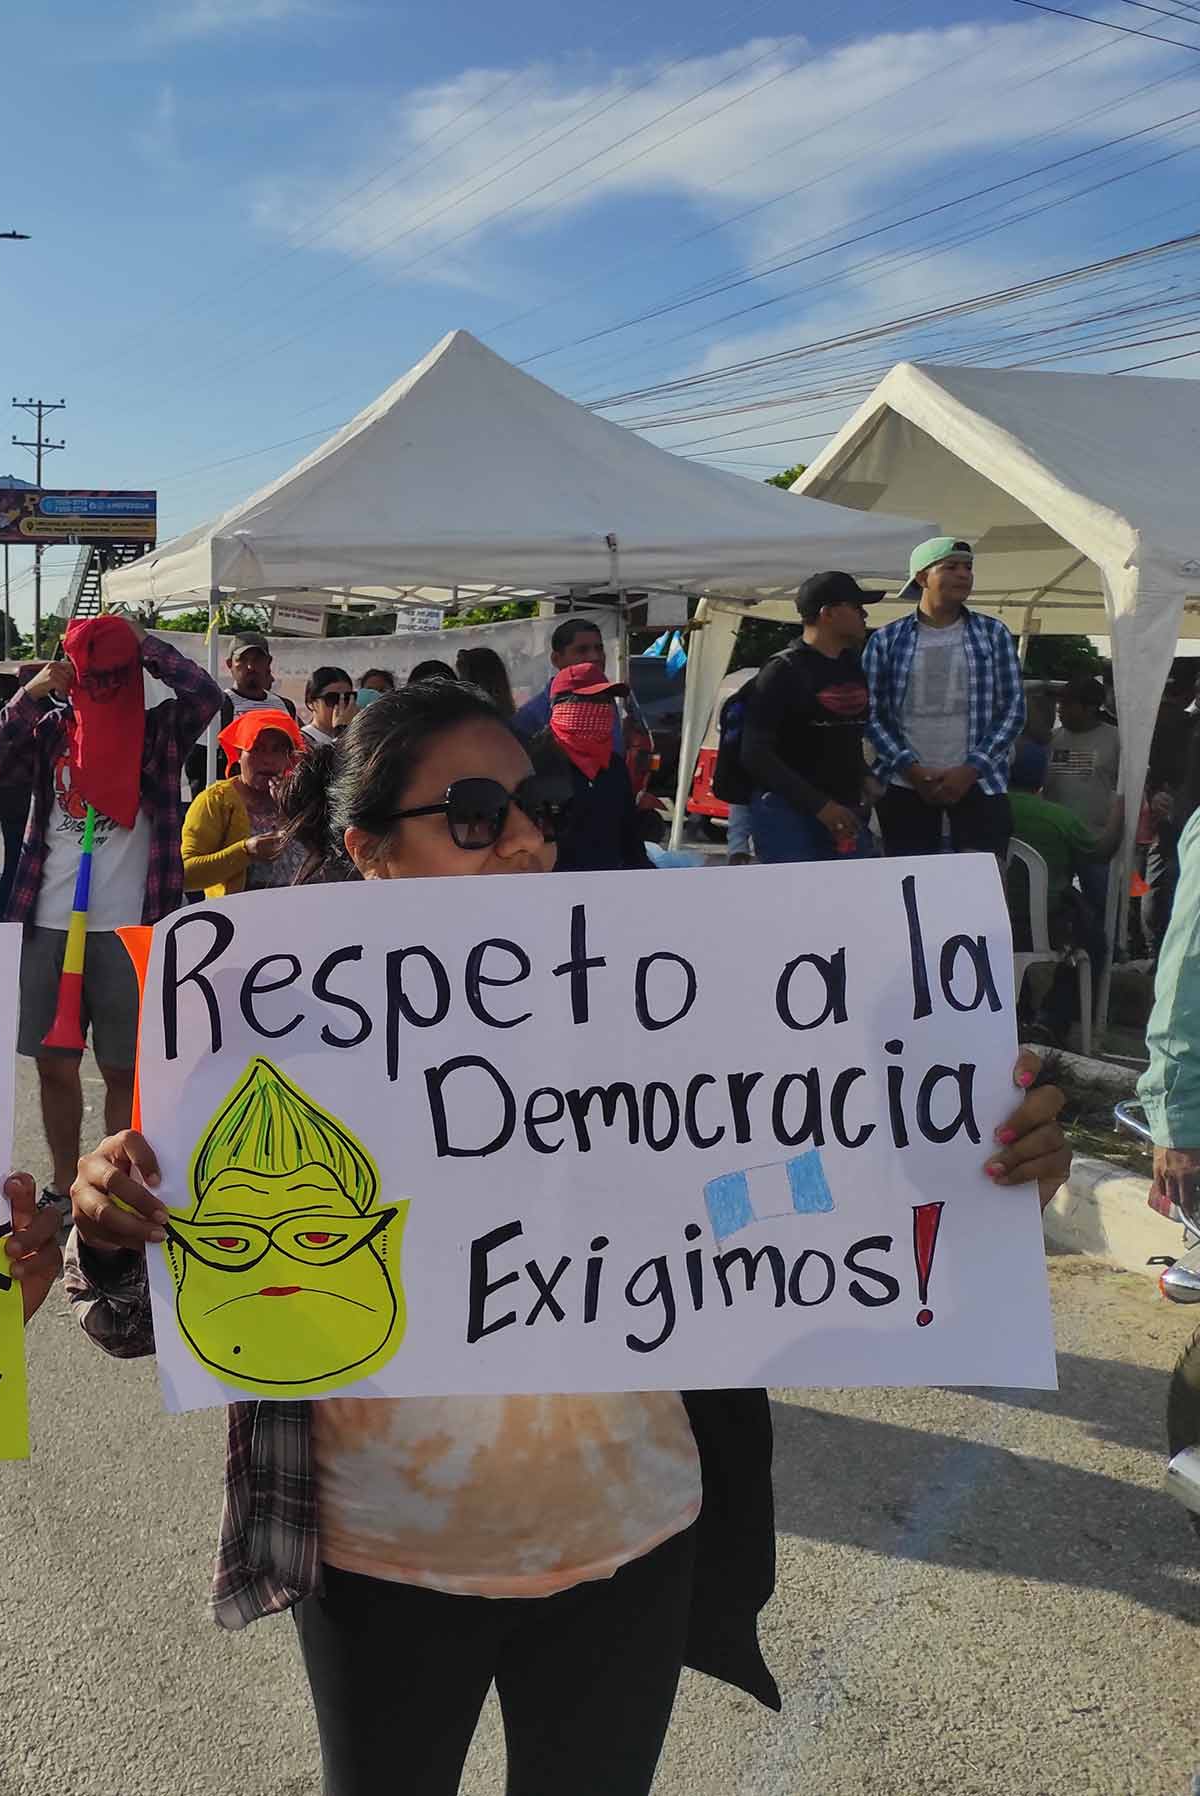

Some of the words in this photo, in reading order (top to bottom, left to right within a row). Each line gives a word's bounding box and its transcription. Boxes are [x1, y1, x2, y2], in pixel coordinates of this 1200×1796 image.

[162, 904, 697, 1081] Respeto
[776, 946, 849, 1031] a
[901, 875, 1003, 1020] la
[424, 1039, 982, 1157] Democracia
[467, 1201, 945, 1353] Exigimos!
